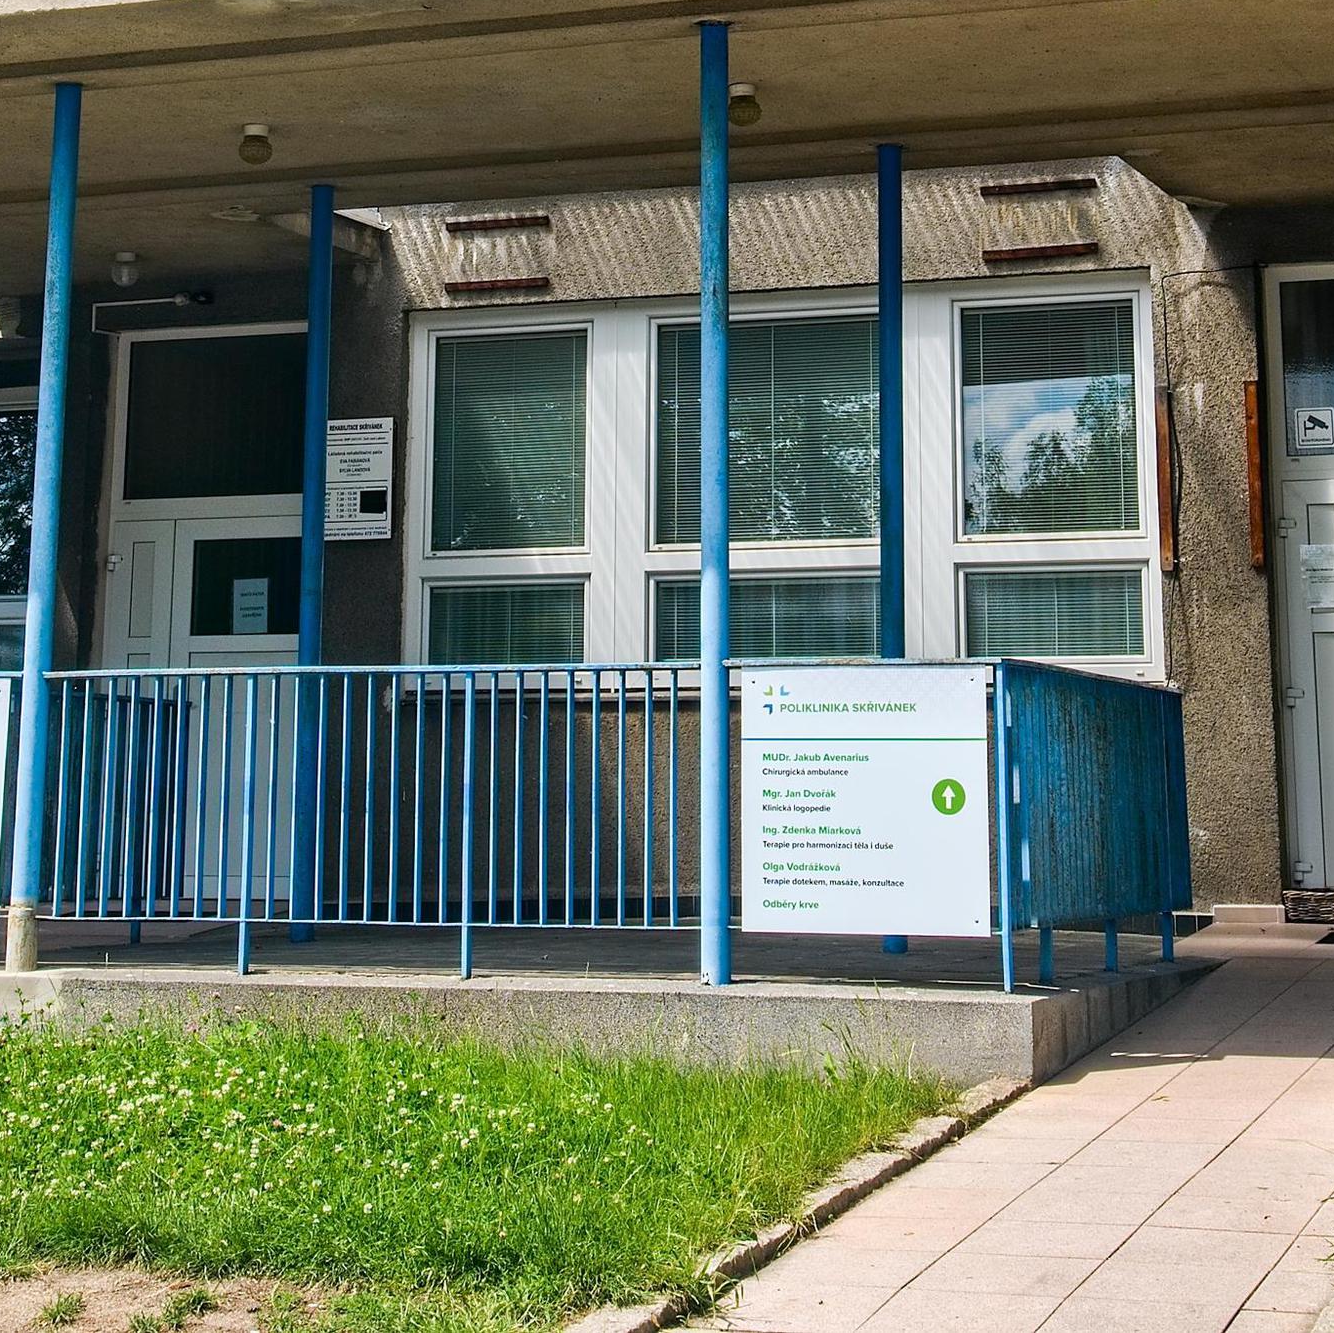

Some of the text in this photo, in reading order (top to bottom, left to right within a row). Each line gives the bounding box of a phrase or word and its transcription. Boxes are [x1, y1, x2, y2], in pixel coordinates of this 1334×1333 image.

[780, 701, 916, 712] POLIKLINIKA SKŘIVÁNEK
[763, 753, 791, 761] MUDr.
[762, 768, 848, 777] Chirurgická ambulance
[763, 790, 782, 799] Mgr.
[803, 789, 836, 798] Dvořák
[794, 804, 831, 814] logopedie
[763, 826, 779, 836] Ing.
[783, 826, 816, 834] Zdenka
[763, 841, 790, 850] Terapie
[875, 842, 893, 850] duše
[763, 862, 840, 873] Olga Vodrážková
[763, 877, 904, 887] Terapie dotekem, masáže, konzultace
[763, 900, 819, 910] Odběry krve
